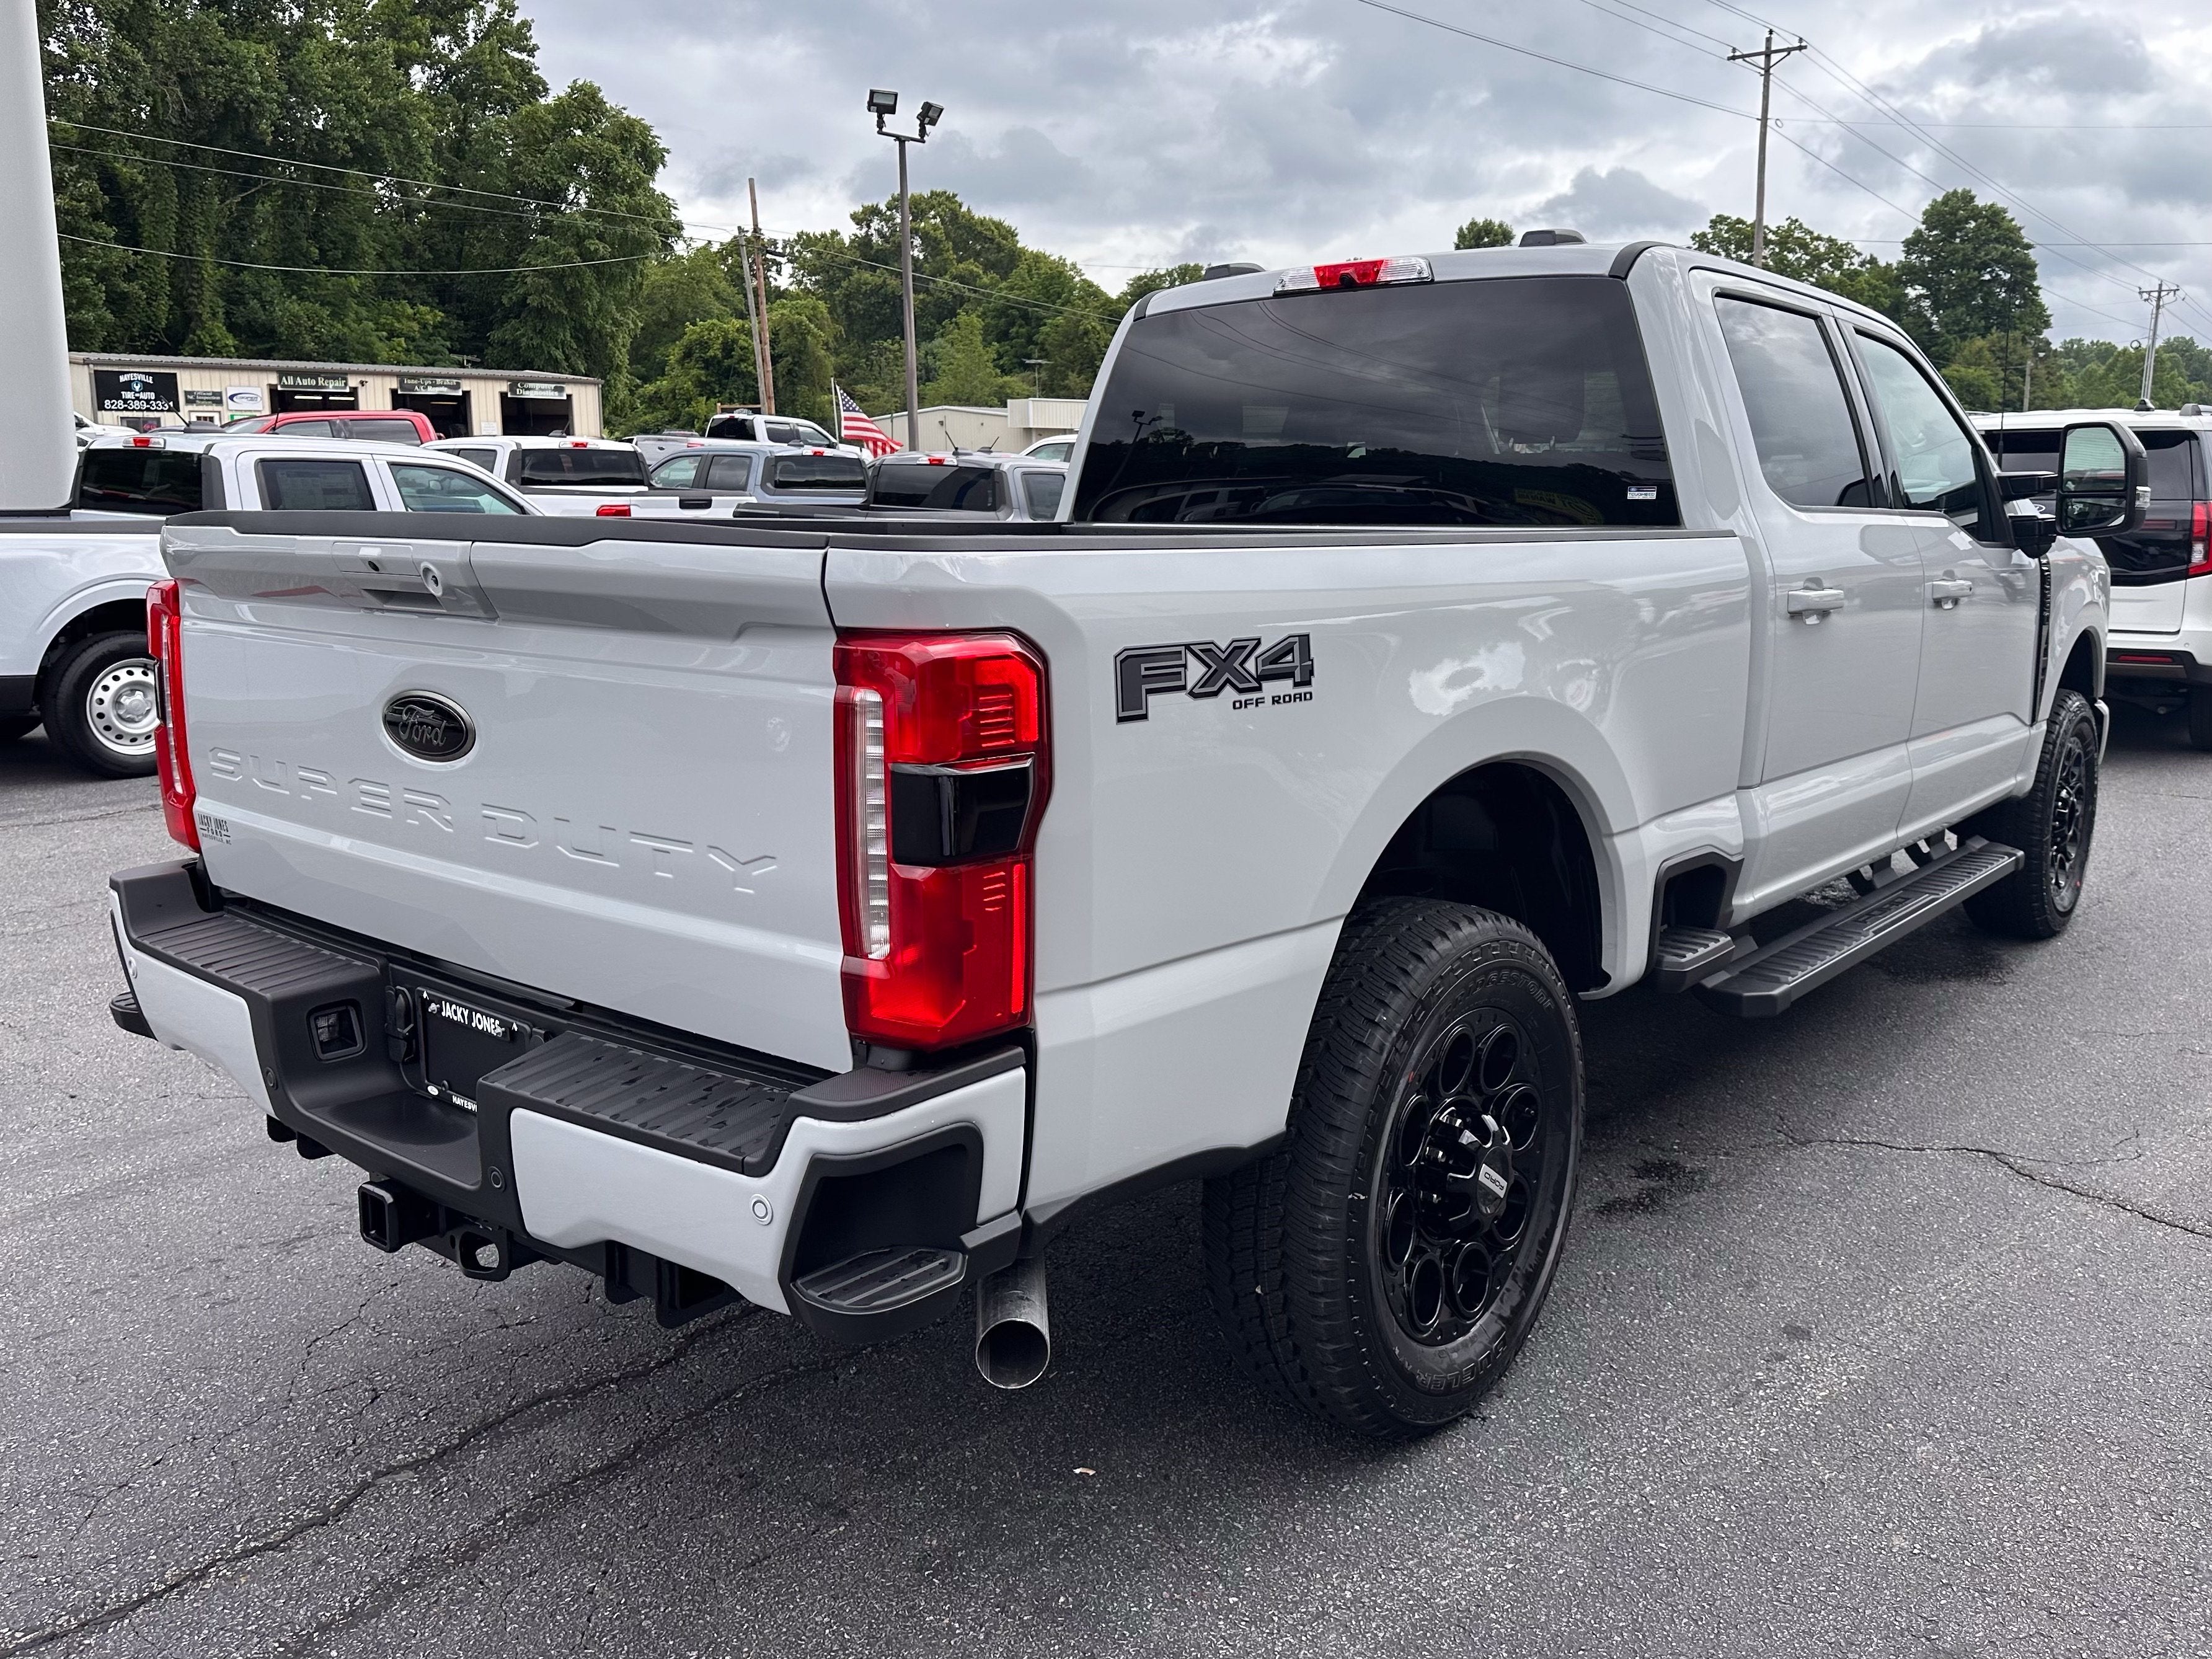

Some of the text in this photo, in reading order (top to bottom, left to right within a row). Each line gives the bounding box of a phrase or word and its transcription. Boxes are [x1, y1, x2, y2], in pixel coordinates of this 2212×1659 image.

[119, 373, 154, 384] HAYESVILLE
[281, 376, 346, 389] All Auto Repair
[517, 382, 554, 391] Computer
[121, 391, 155, 400] TIRE AUTO
[516, 388, 559, 397] Diagnostics
[1113, 632, 1314, 725] FX4
[1232, 691, 1314, 710] OFF ROAD
[399, 704, 446, 746] Ford
[208, 746, 777, 893] SUPER DUTY
[206, 827, 223, 837] FORD
[1438, 969, 1554, 1027] BRIDGESTONE
[441, 1001, 500, 1037] JACKY JONES
[1484, 1171, 1505, 1191] FORD
[1415, 1330, 1508, 1391] DUELER
